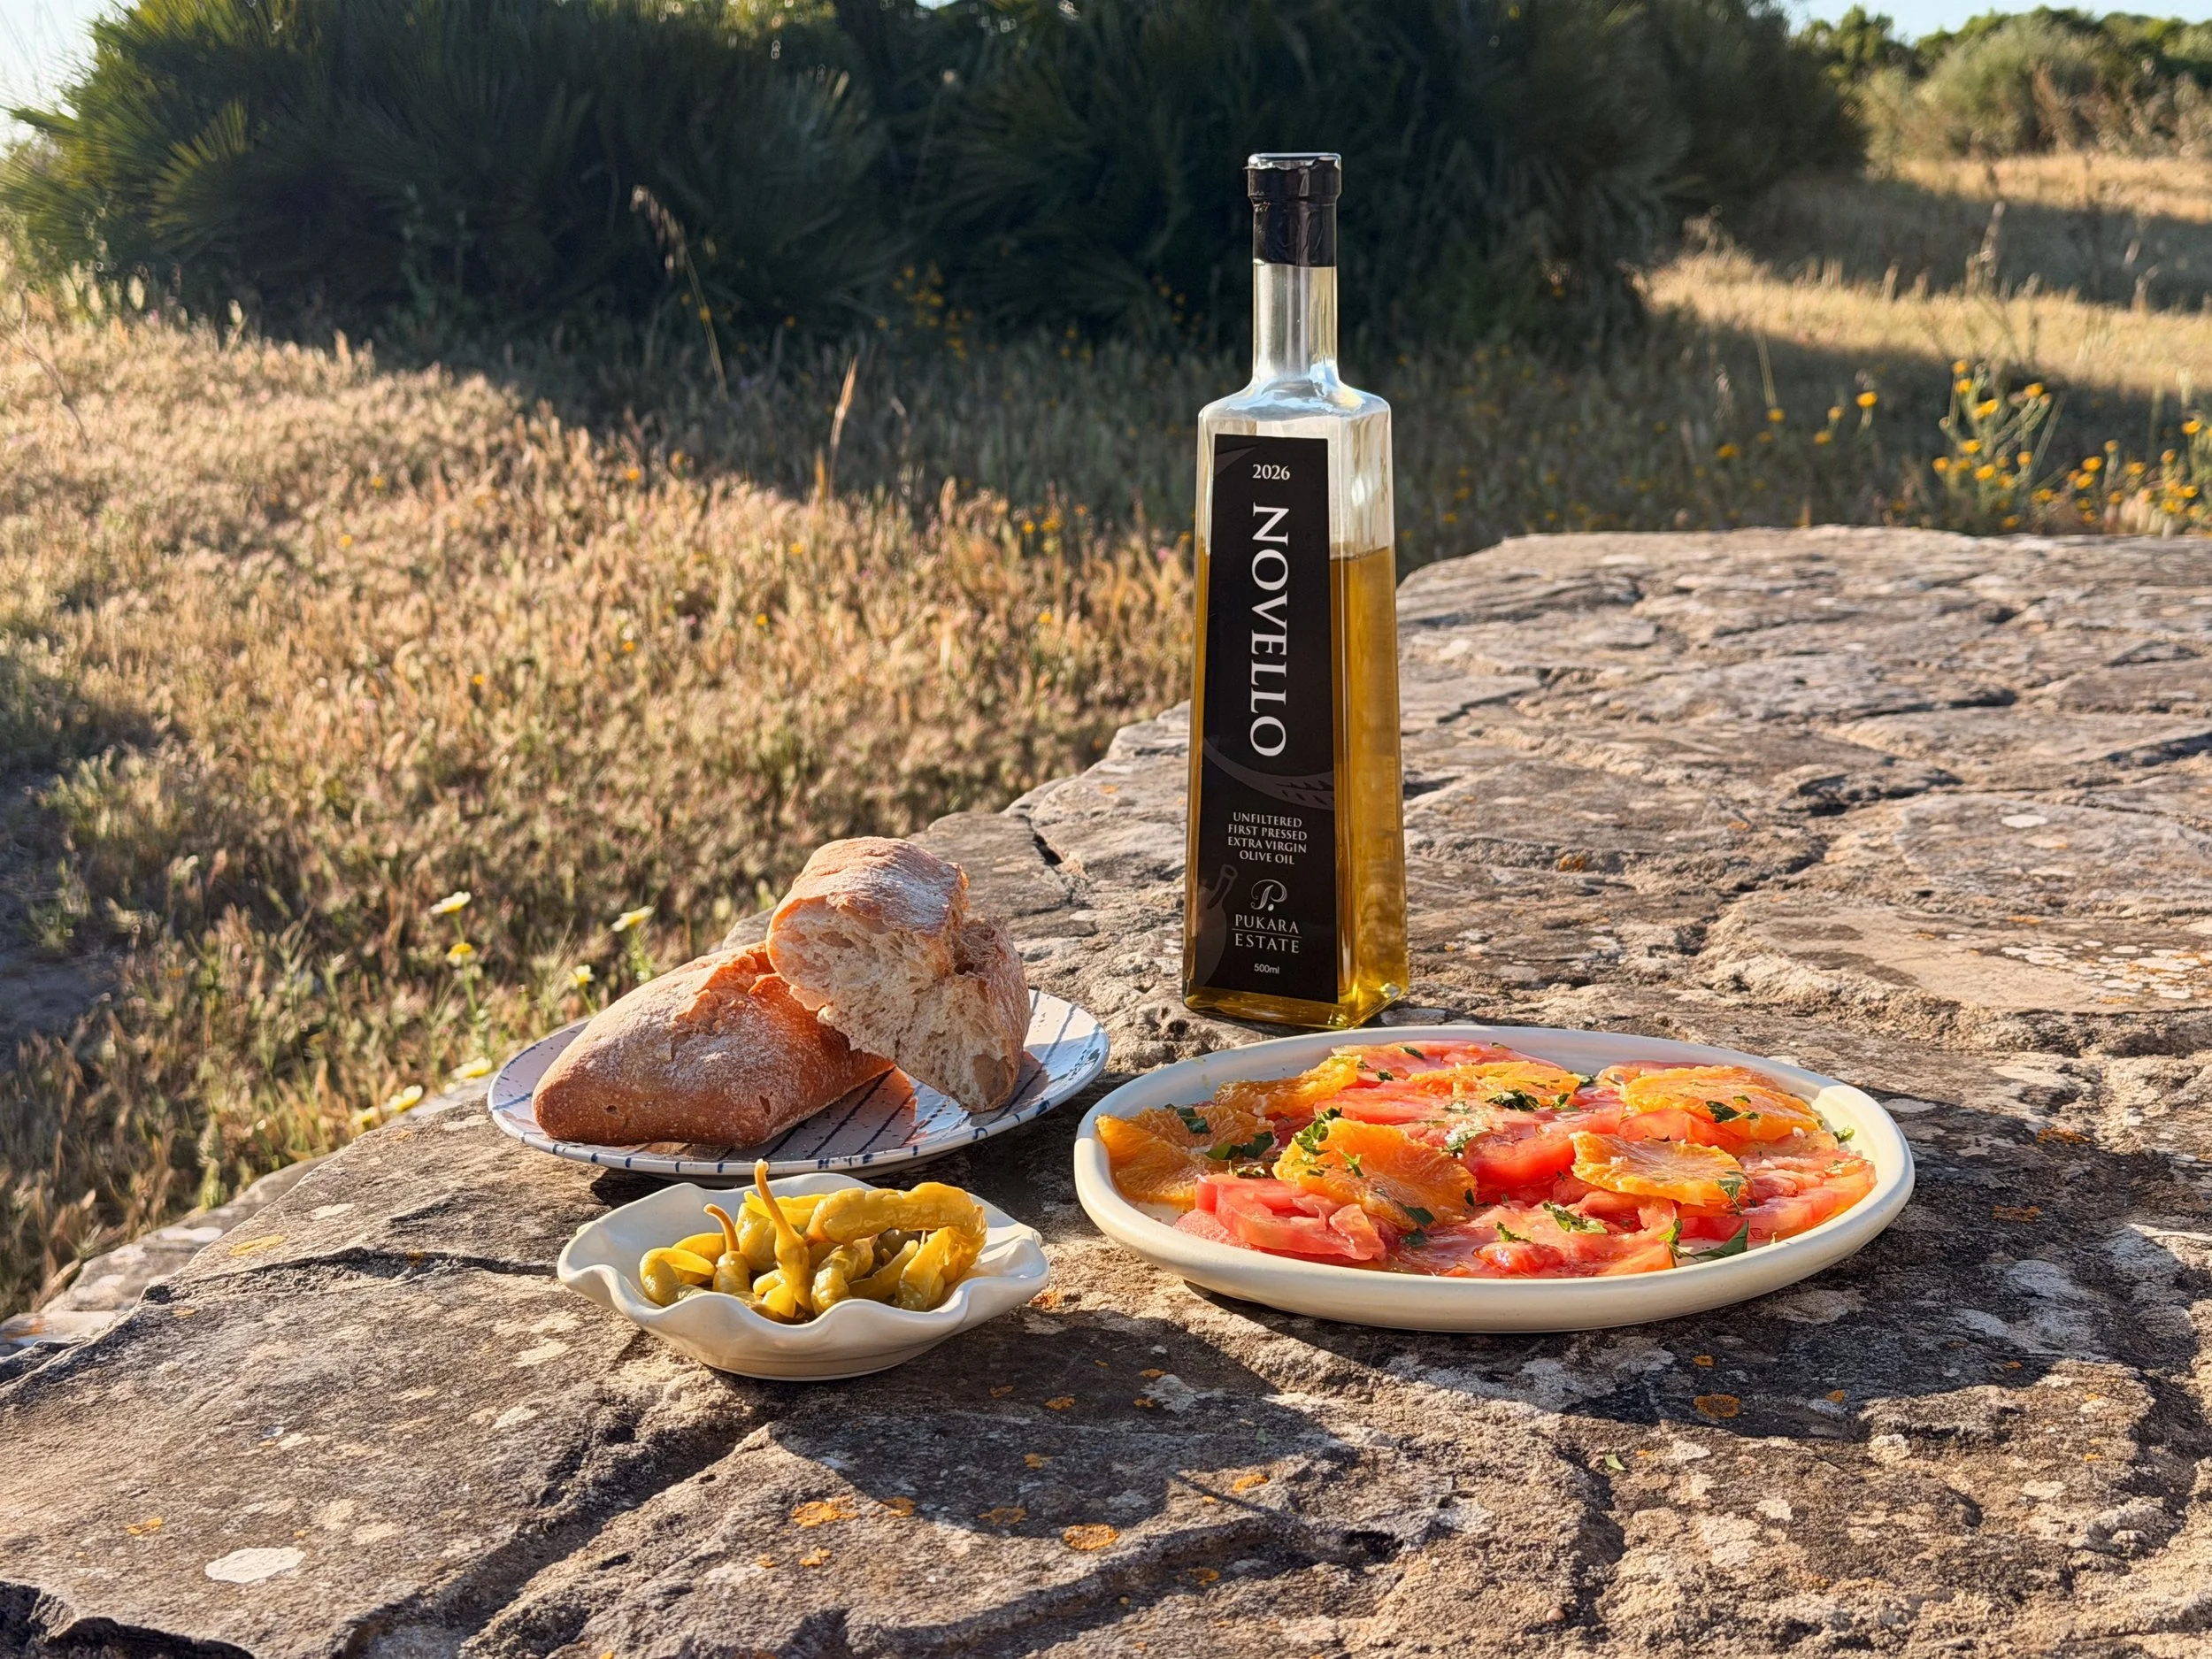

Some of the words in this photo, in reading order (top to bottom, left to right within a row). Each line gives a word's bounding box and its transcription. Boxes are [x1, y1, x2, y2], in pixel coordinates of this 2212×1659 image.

[1252, 464, 1291, 480] 2026
[1249, 502, 1290, 757] NOVELLO
[1233, 811, 1302, 828] UNFILTERED
[1227, 824, 1257, 836] FIRST
[1261, 827, 1308, 841] PRESSED
[1227, 836, 1263, 849] EXTRA
[1265, 839, 1307, 853] VIRGIN
[1240, 850, 1272, 863] OLIVE
[1275, 853, 1295, 865] OIL
[1234, 914, 1300, 934] PUKARA
[1234, 933, 1300, 954] ESTATE
[1253, 963, 1280, 975] 500ml
